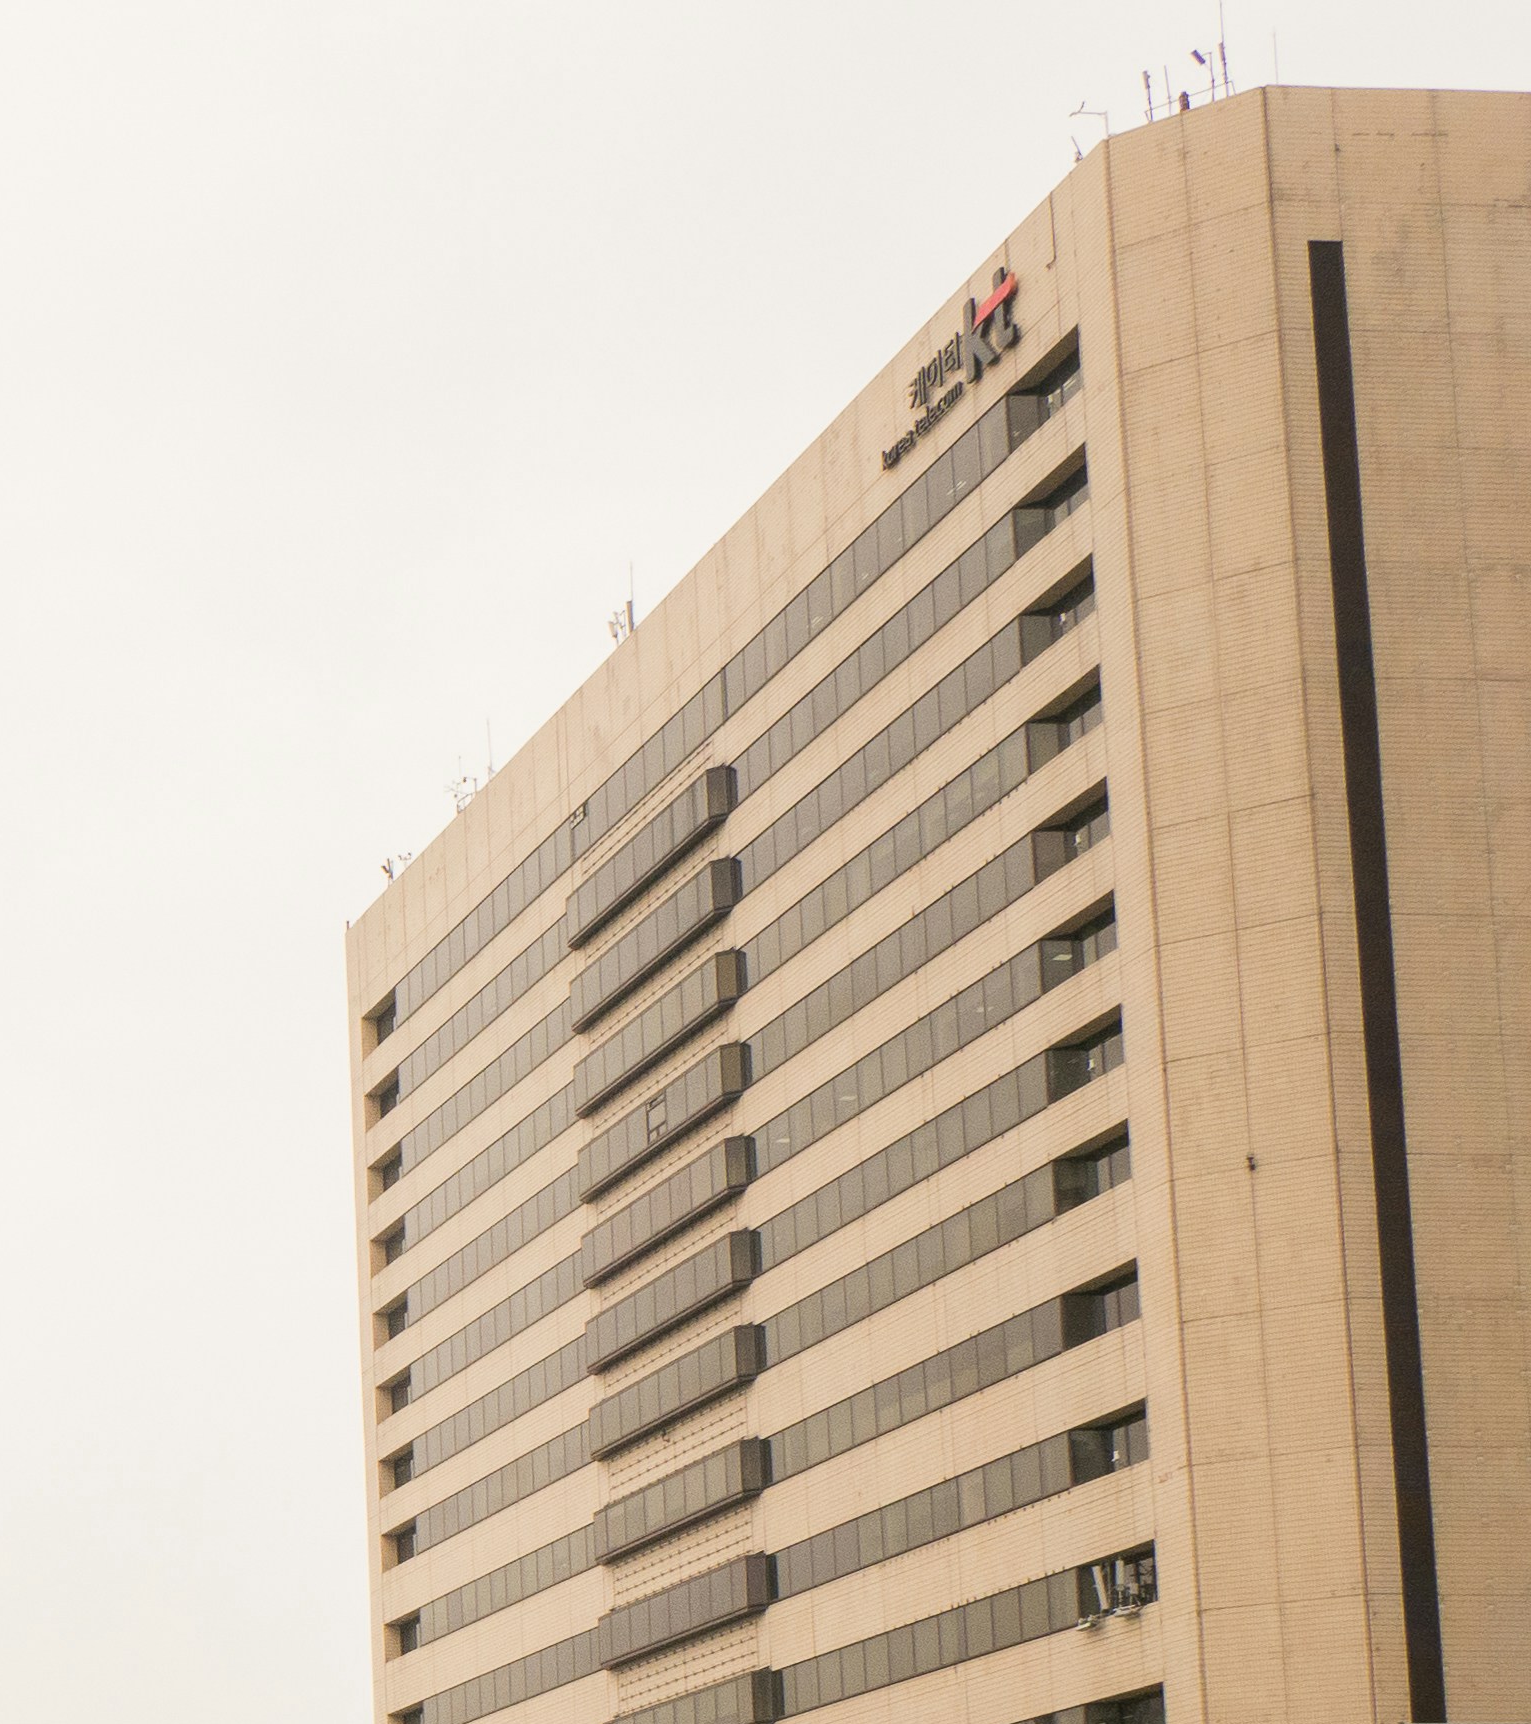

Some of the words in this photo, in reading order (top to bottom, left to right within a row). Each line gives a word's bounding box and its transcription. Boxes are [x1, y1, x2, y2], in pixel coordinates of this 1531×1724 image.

[962, 266, 1017, 384] kt
[908, 332, 962, 410] 케이티
[882, 429, 917, 471] korea
[914, 381, 964, 438] telecom
